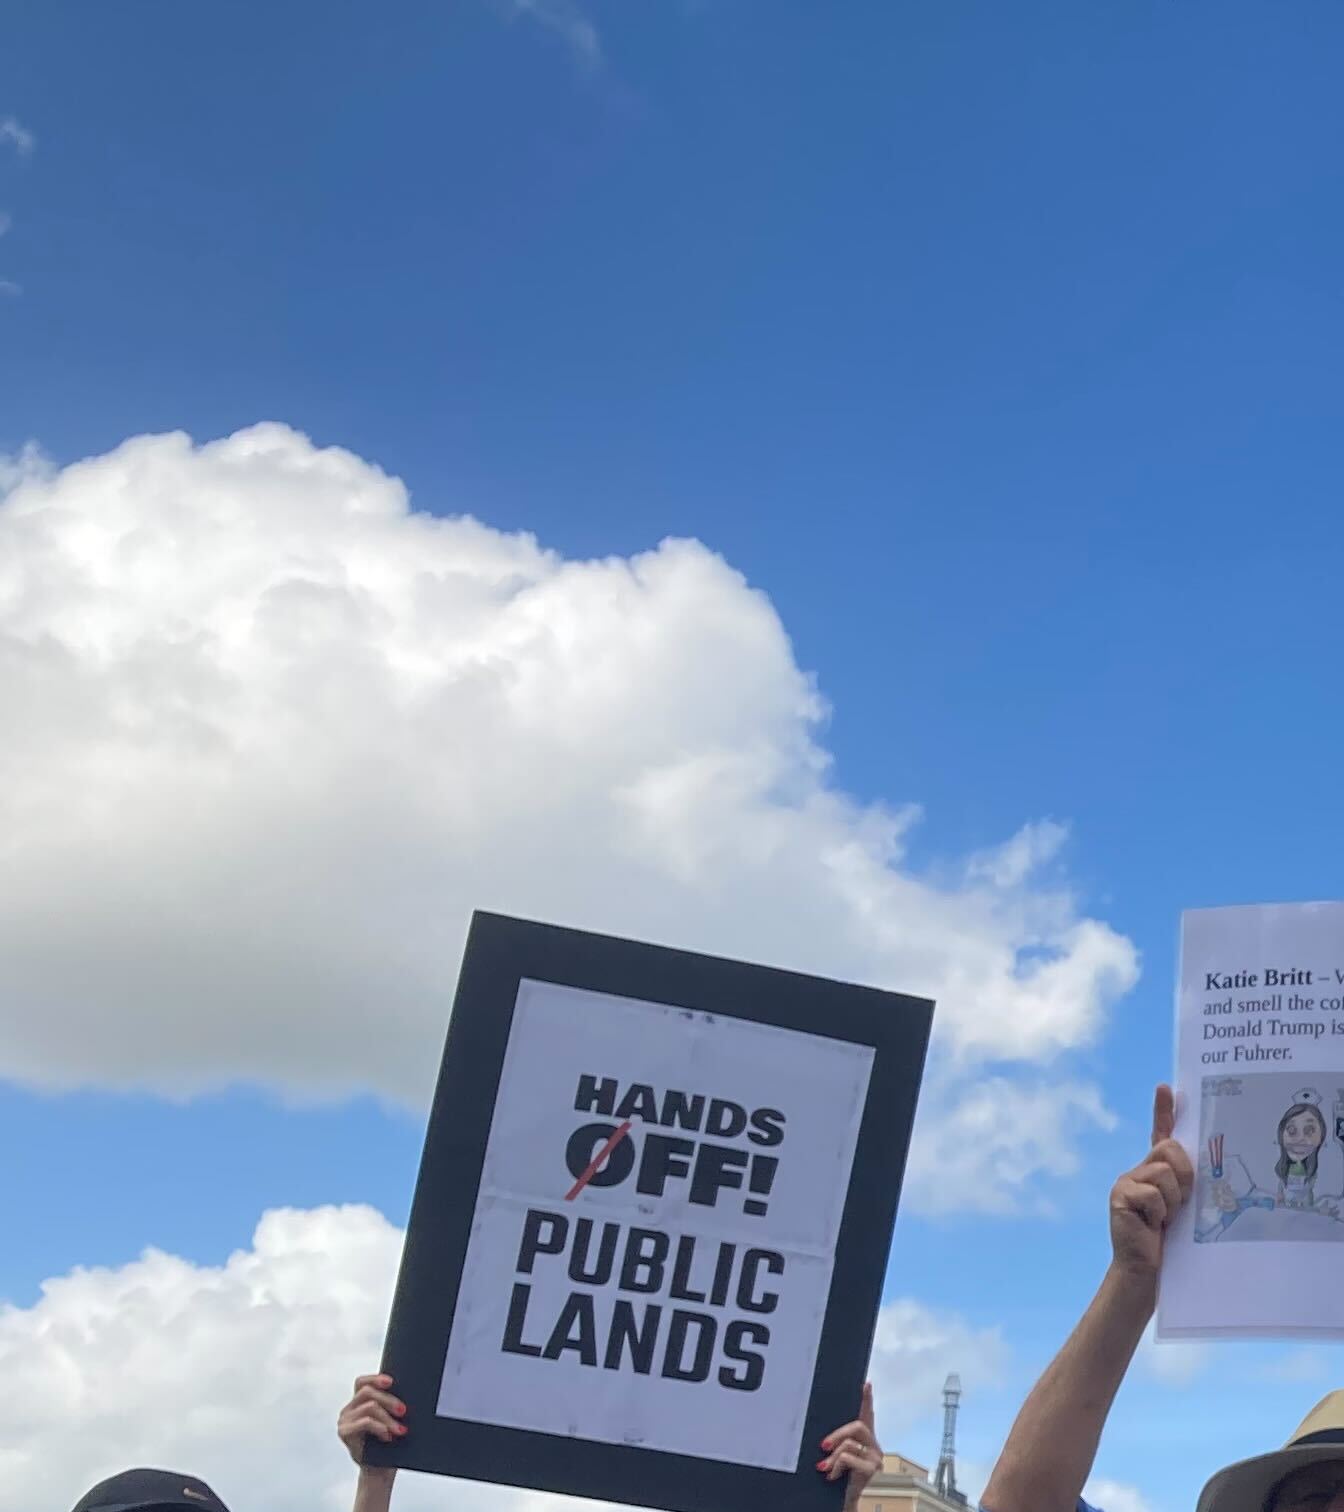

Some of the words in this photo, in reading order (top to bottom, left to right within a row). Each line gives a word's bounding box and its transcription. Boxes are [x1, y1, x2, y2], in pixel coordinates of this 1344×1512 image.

[1205, 970, 1259, 992] Katie
[1263, 968, 1312, 987] Britt
[1203, 996, 1233, 1016] and
[1237, 994, 1283, 1013] smell
[1287, 994, 1315, 1011] the
[1203, 1020, 1262, 1040] Donald
[1266, 1019, 1325, 1039] Trump
[1201, 1049, 1228, 1065] our
[1233, 1044, 1293, 1063] Fuhrer.
[574, 1074, 787, 1147] HANDS
[565, 1123, 779, 1217] OFF!
[516, 1208, 786, 1314] PUBLIC
[501, 1283, 771, 1392] LANDS
